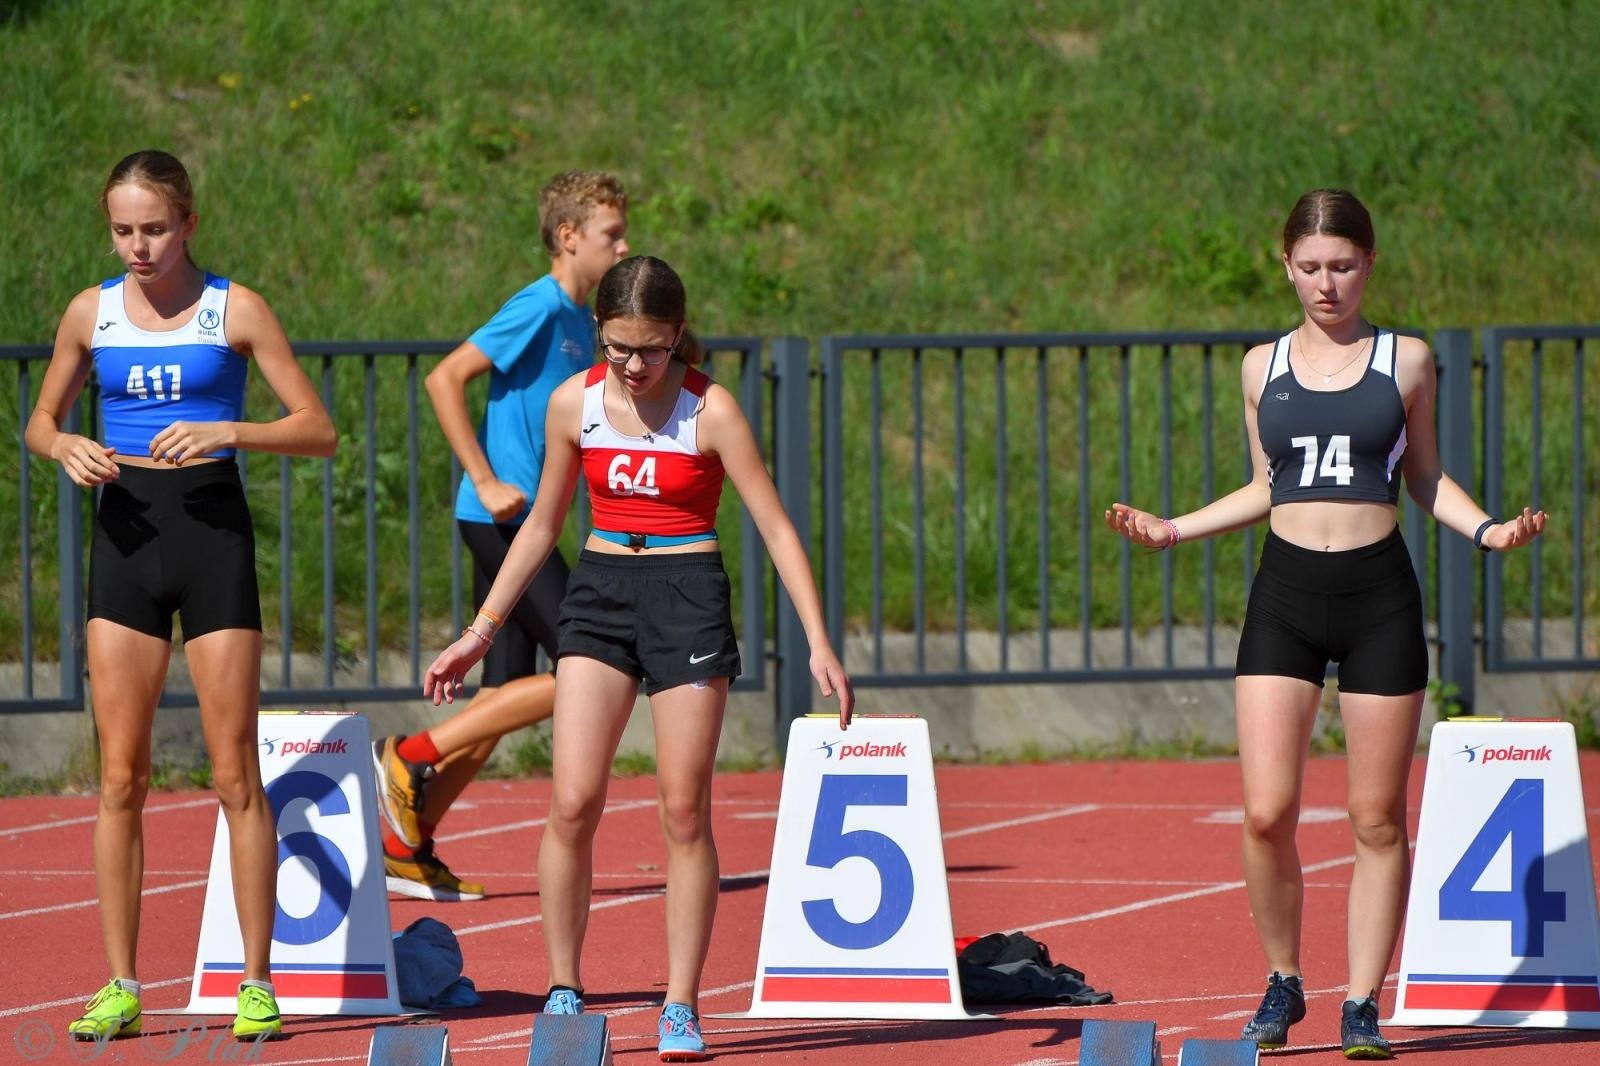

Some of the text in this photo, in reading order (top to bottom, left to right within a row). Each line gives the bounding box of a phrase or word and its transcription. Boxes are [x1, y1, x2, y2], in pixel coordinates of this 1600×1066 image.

[126, 364, 182, 401] 417
[607, 453, 660, 496] 64
[1291, 434, 1354, 487] 74
[280, 738, 348, 757] polanik
[839, 741, 908, 761] polanik
[1482, 744, 1553, 765] polanik
[264, 770, 352, 946] 6
[801, 774, 915, 950] 5
[1439, 778, 1567, 958] 4
